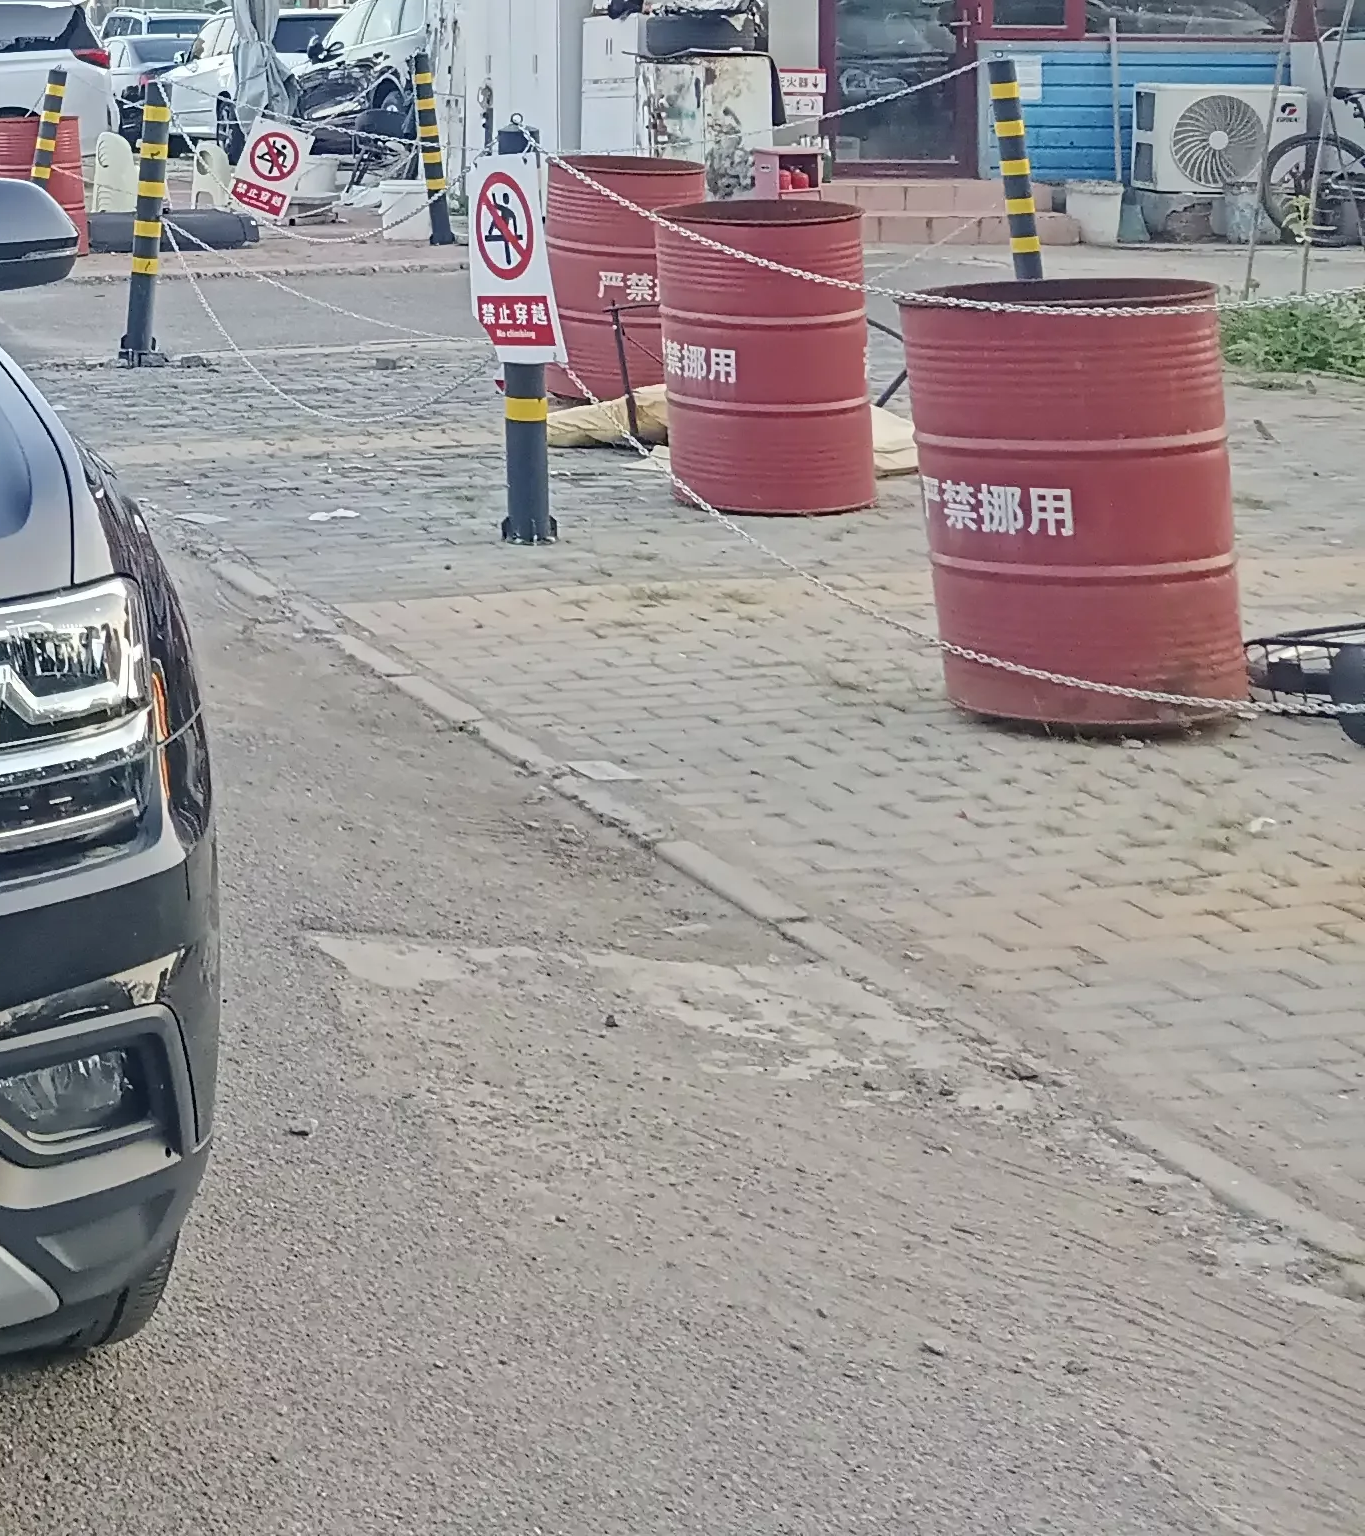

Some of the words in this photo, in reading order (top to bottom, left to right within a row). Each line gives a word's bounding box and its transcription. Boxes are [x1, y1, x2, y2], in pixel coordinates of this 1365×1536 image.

[597, 271, 661, 302] 严禁
[481, 302, 548, 325] 禁止穿越
[663, 338, 736, 383] 禁挪用
[922, 475, 1074, 536] 严禁挪用
